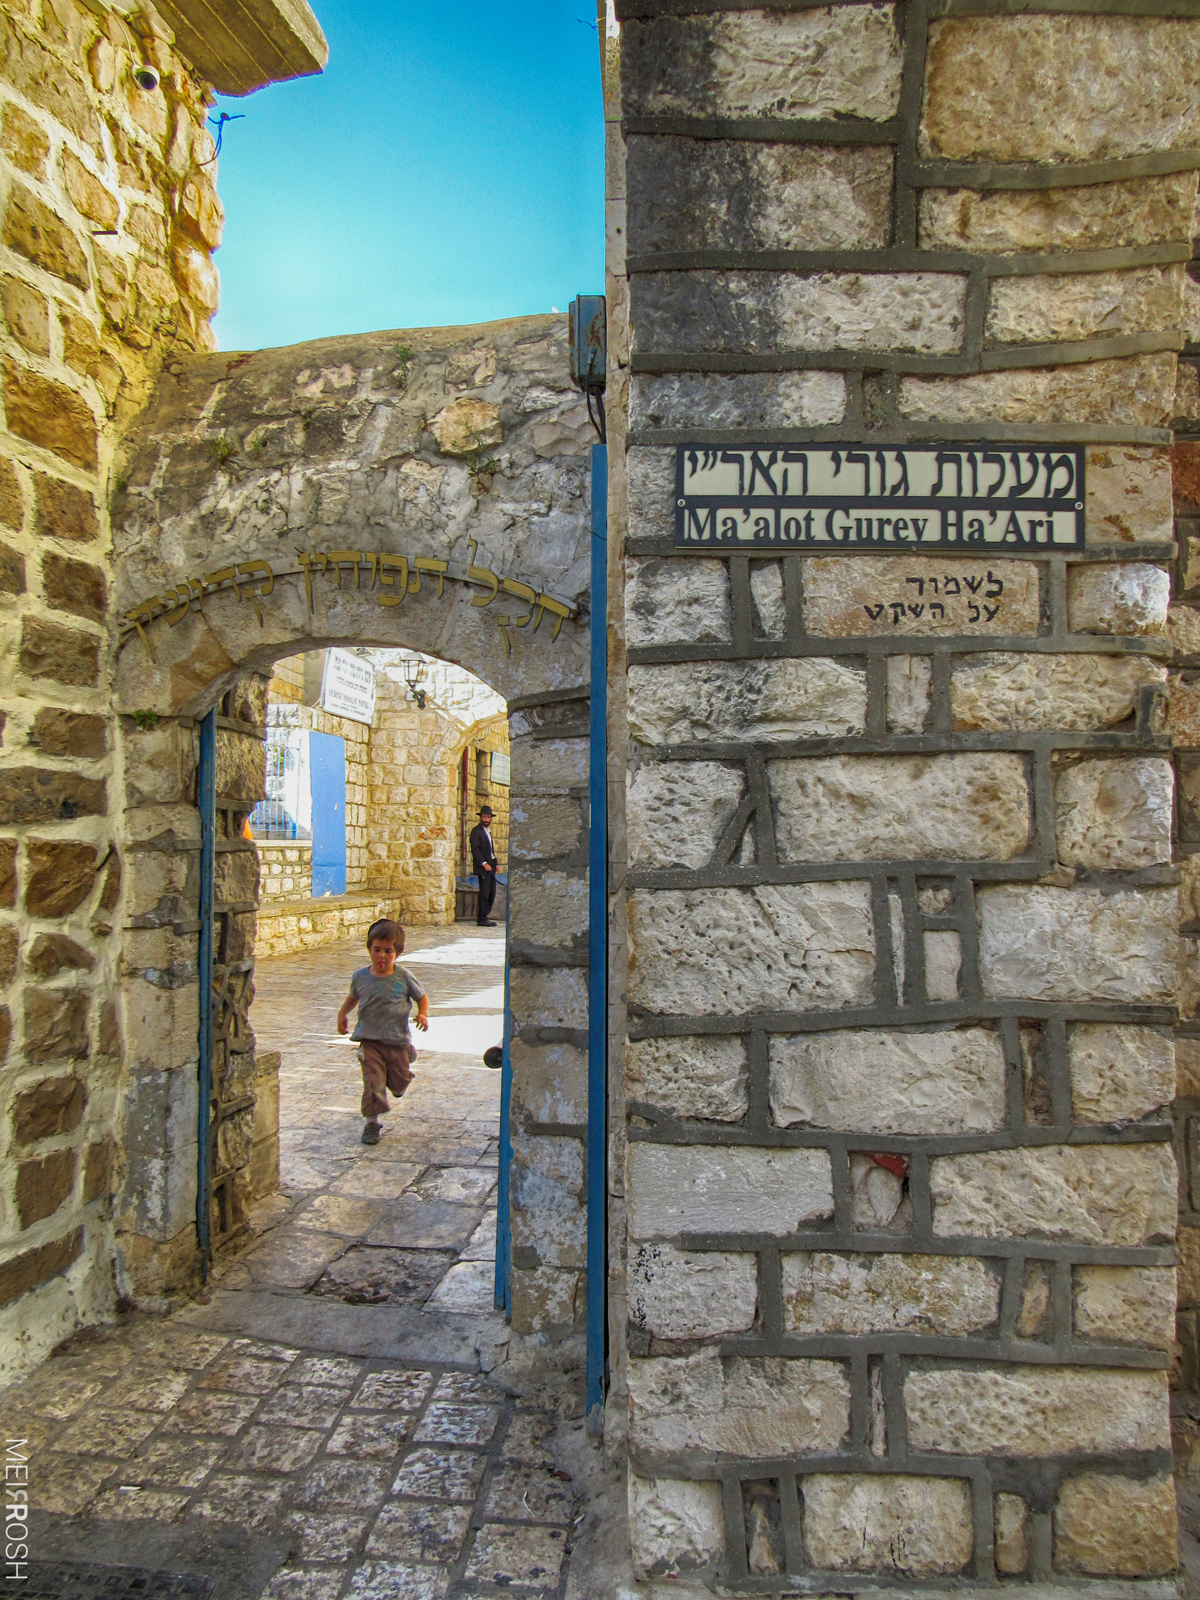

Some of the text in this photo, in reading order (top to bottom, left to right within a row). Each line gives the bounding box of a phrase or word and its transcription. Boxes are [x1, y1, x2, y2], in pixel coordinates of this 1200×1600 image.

[830, 450, 909, 497] גורי
[930, 450, 1074, 499] מעלות
[685, 507, 1054, 544] Ma'alot Gurev Ha'Ari
[298, 550, 449, 616] תפוחין
[905, 570, 1004, 598] לשמור
[125, 560, 273, 664] קדישין
[863, 600, 1000, 626] על השקט
